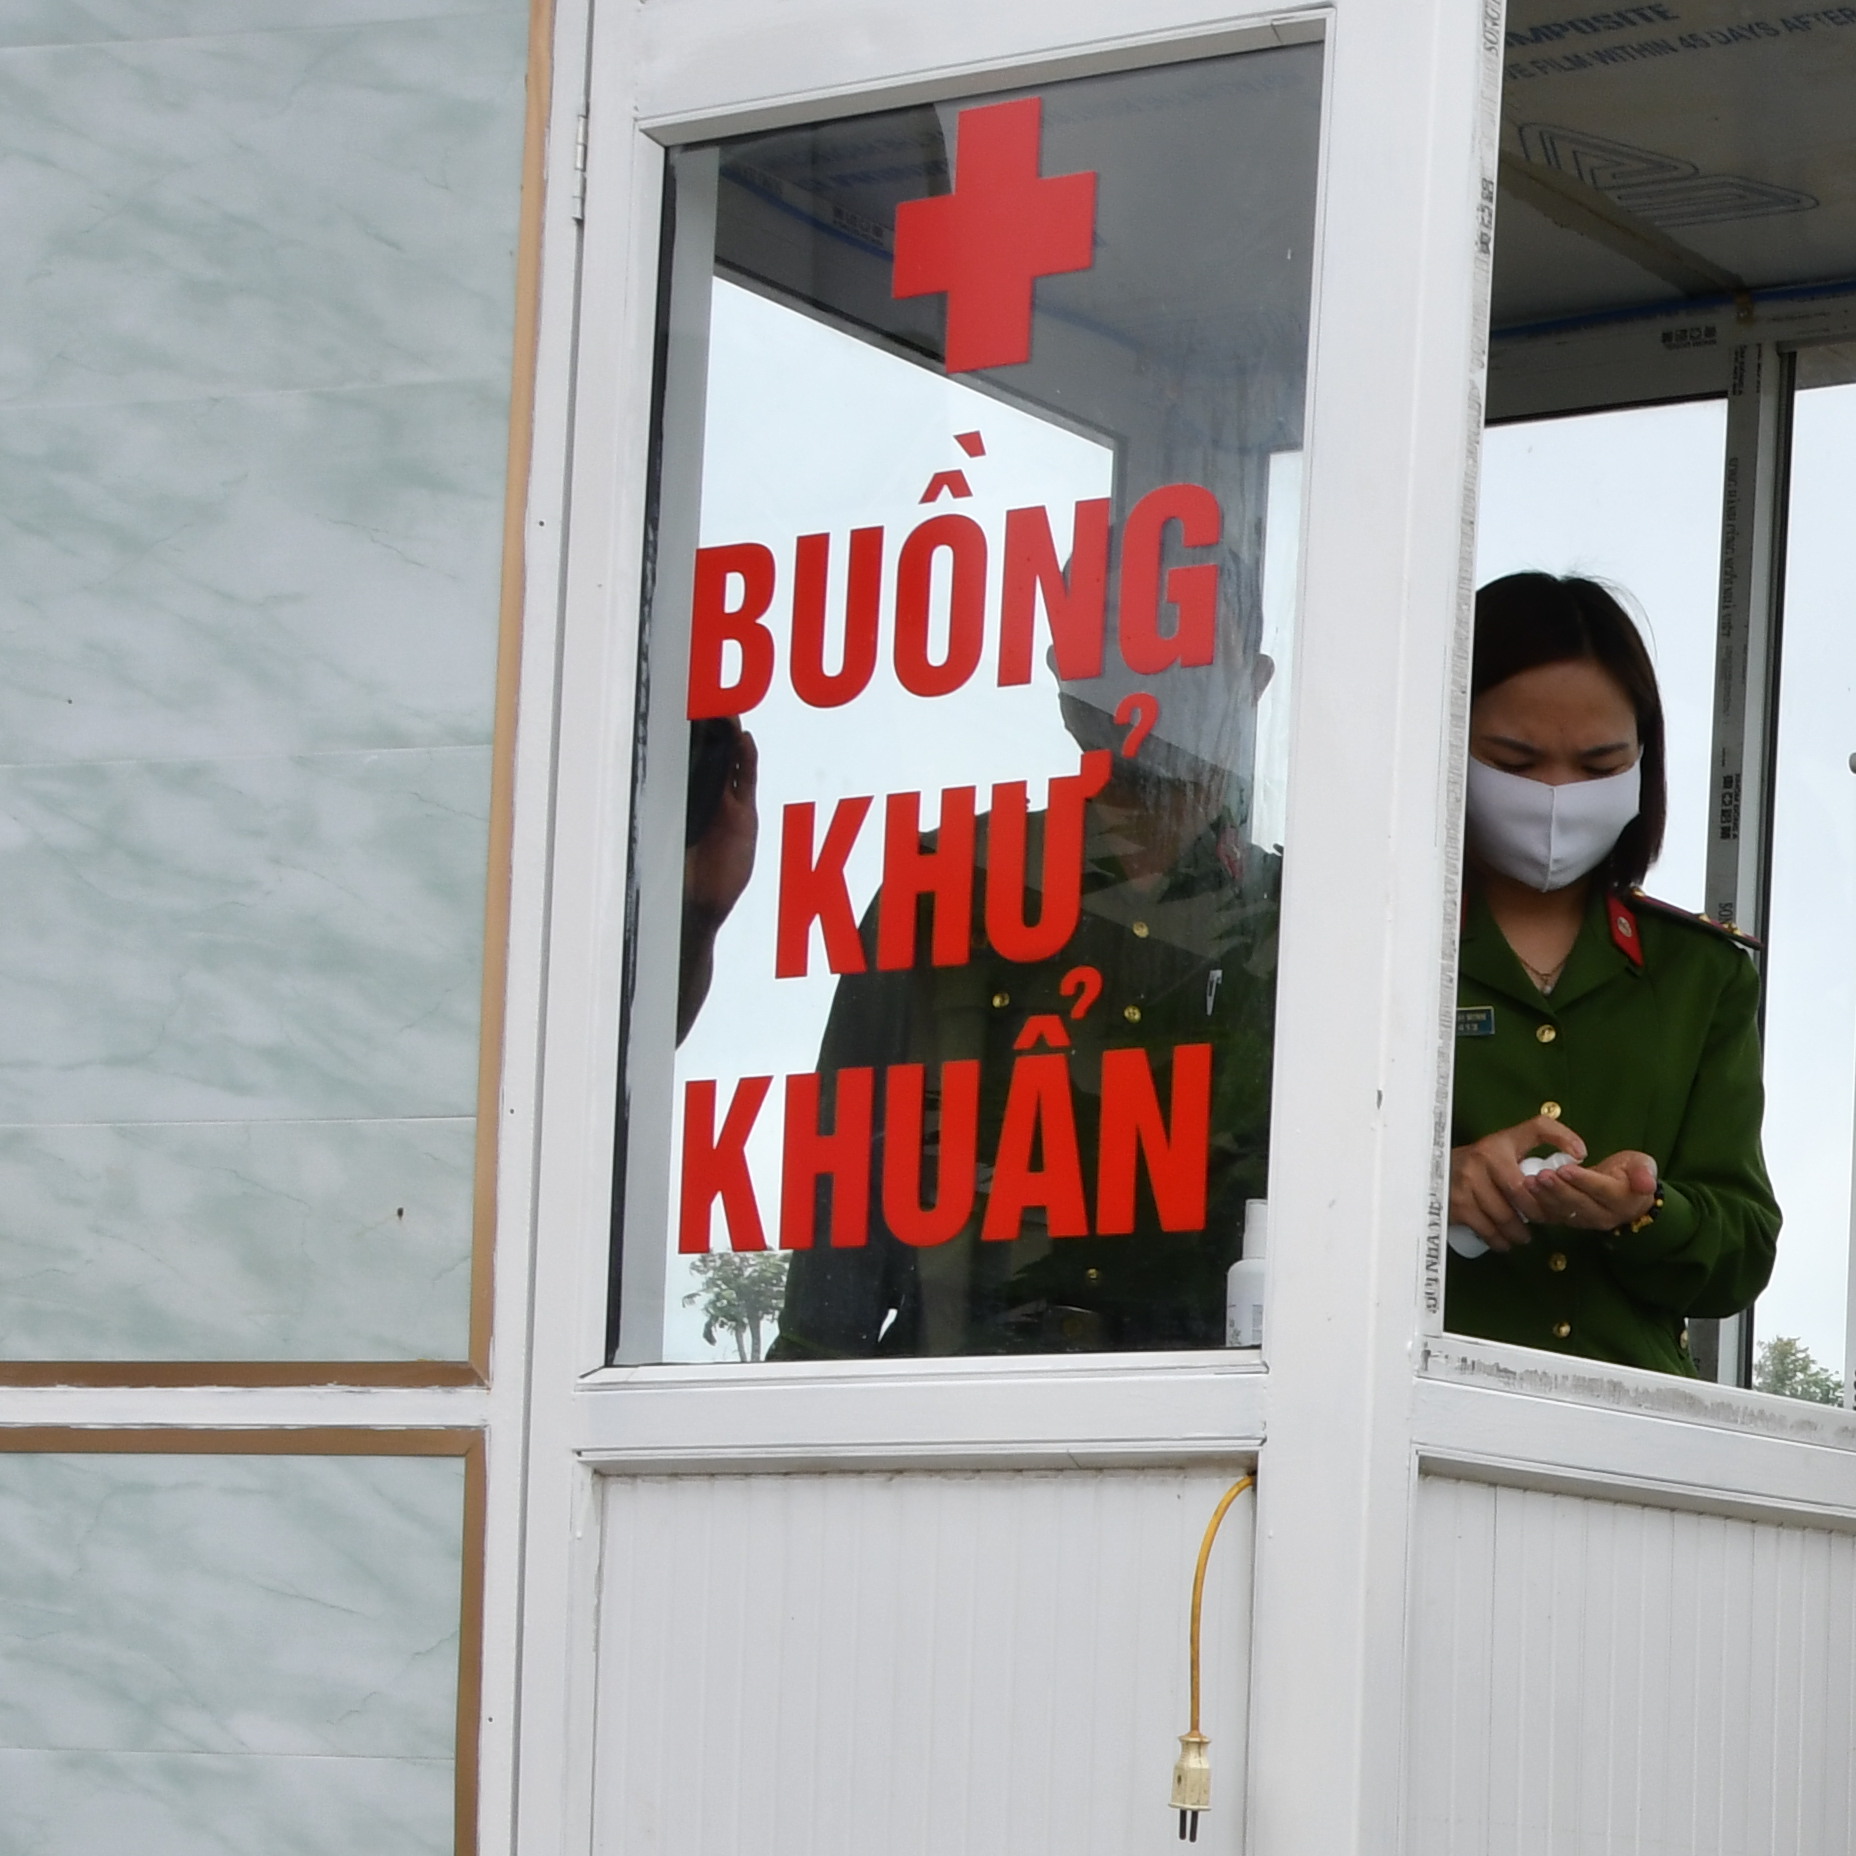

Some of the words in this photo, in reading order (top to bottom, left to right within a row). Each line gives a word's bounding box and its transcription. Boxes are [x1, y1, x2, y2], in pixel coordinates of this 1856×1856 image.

[1587, 39, 1678, 65] WITHIN
[1705, 22, 1780, 45] DAYS
[686, 432, 1220, 721] BUỒNG
[776, 692, 1159, 979] KHỬ
[679, 964, 1213, 1254] KHUẨN
